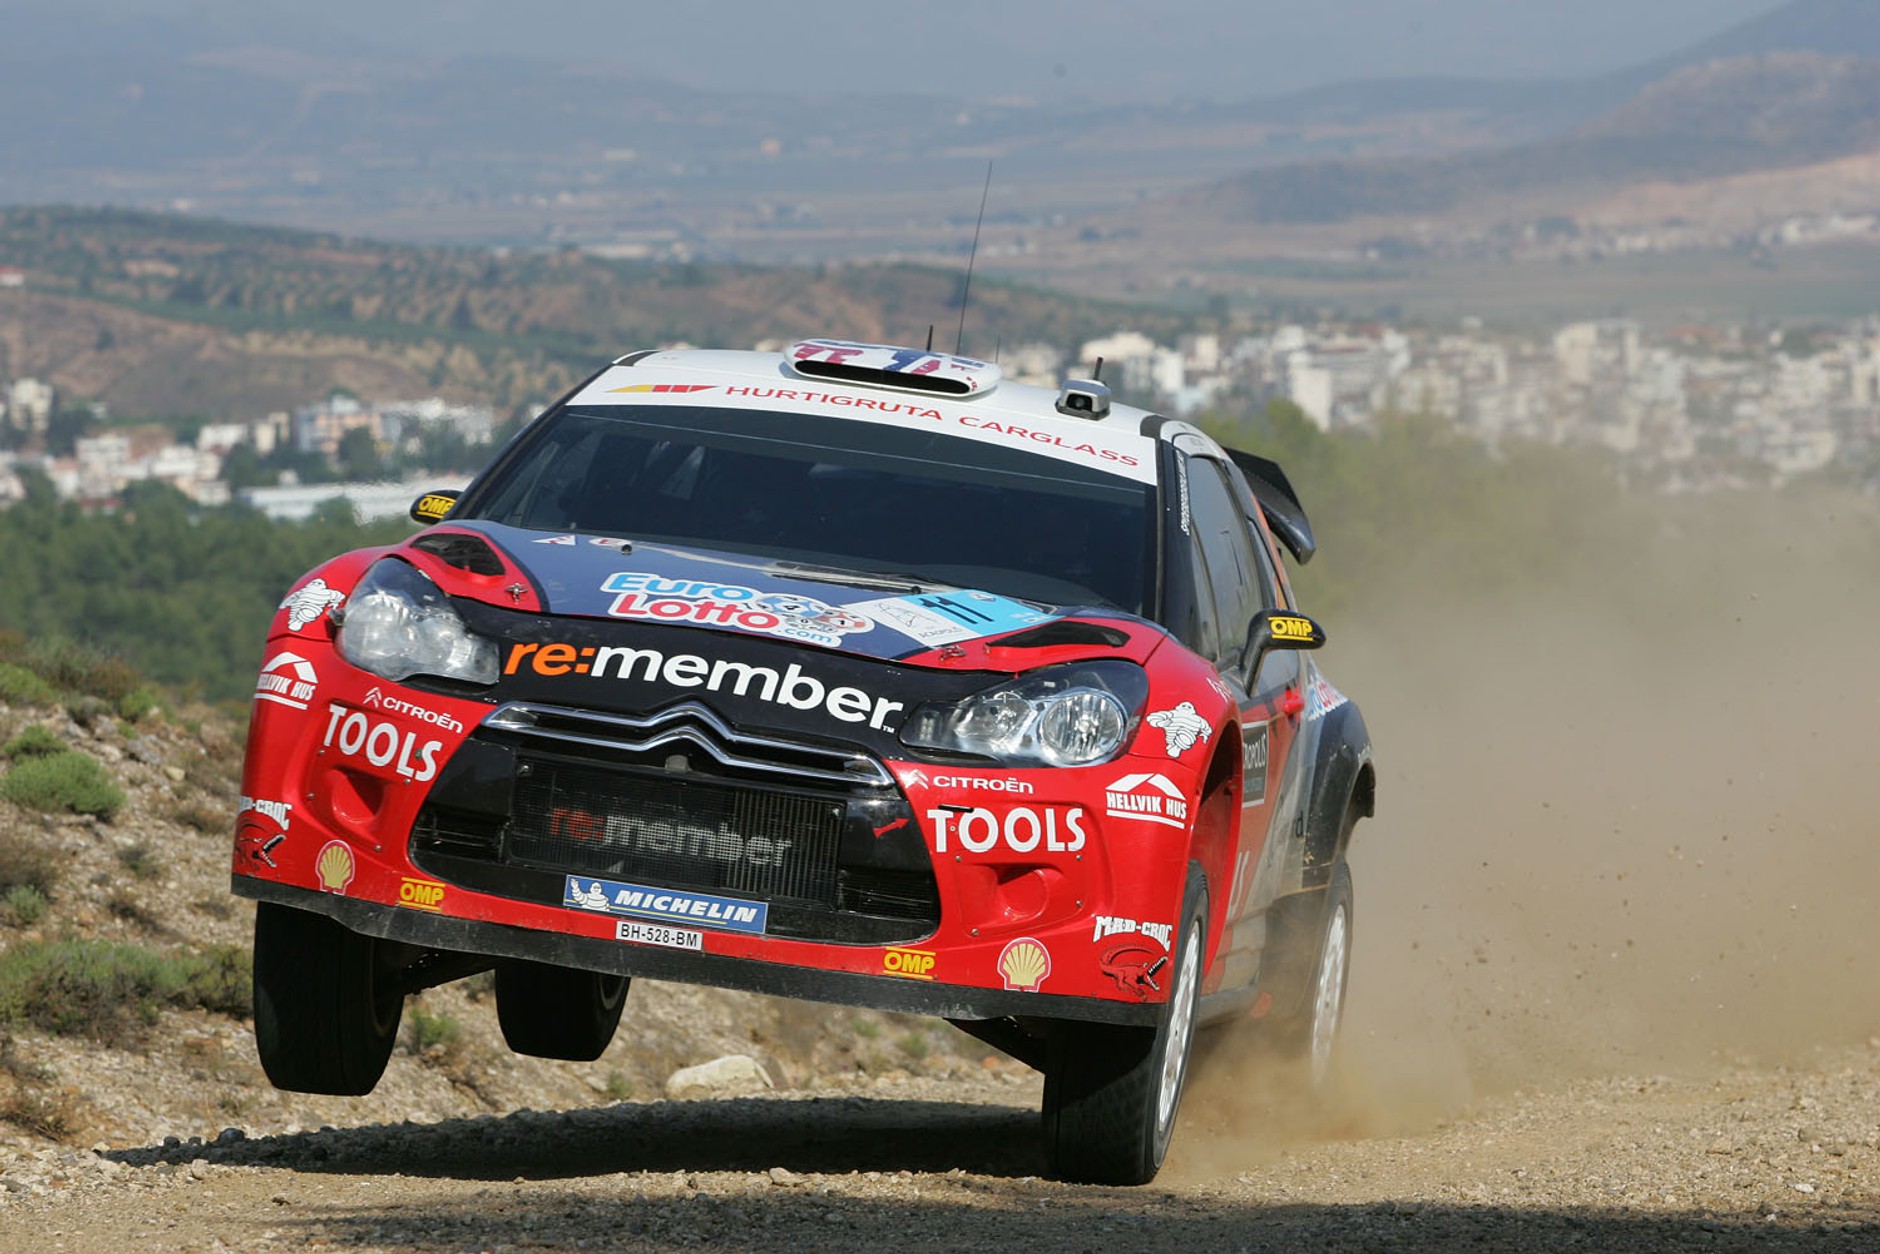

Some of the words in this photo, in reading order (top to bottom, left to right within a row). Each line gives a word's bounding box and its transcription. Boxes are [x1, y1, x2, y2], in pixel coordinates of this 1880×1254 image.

[727, 385, 943, 420] HURTIGRUTA
[958, 416, 1140, 467] CARGLASS
[418, 497, 455, 515] OMP
[615, 593, 779, 629] Lotto
[1269, 618, 1313, 638] OMP
[503, 642, 904, 730] re:member
[323, 703, 443, 782] TOOLS
[1105, 791, 1162, 813] HELLVIK
[1165, 797, 1187, 820] HUS
[549, 807, 792, 867] re:member
[926, 806, 1087, 853] TOOLS
[400, 882, 445, 905] OMP
[614, 889, 758, 924] MICHELIN
[620, 922, 698, 948] BH-528-BM
[1093, 915, 1173, 952] MAD-CROC
[883, 951, 936, 974] OMP
